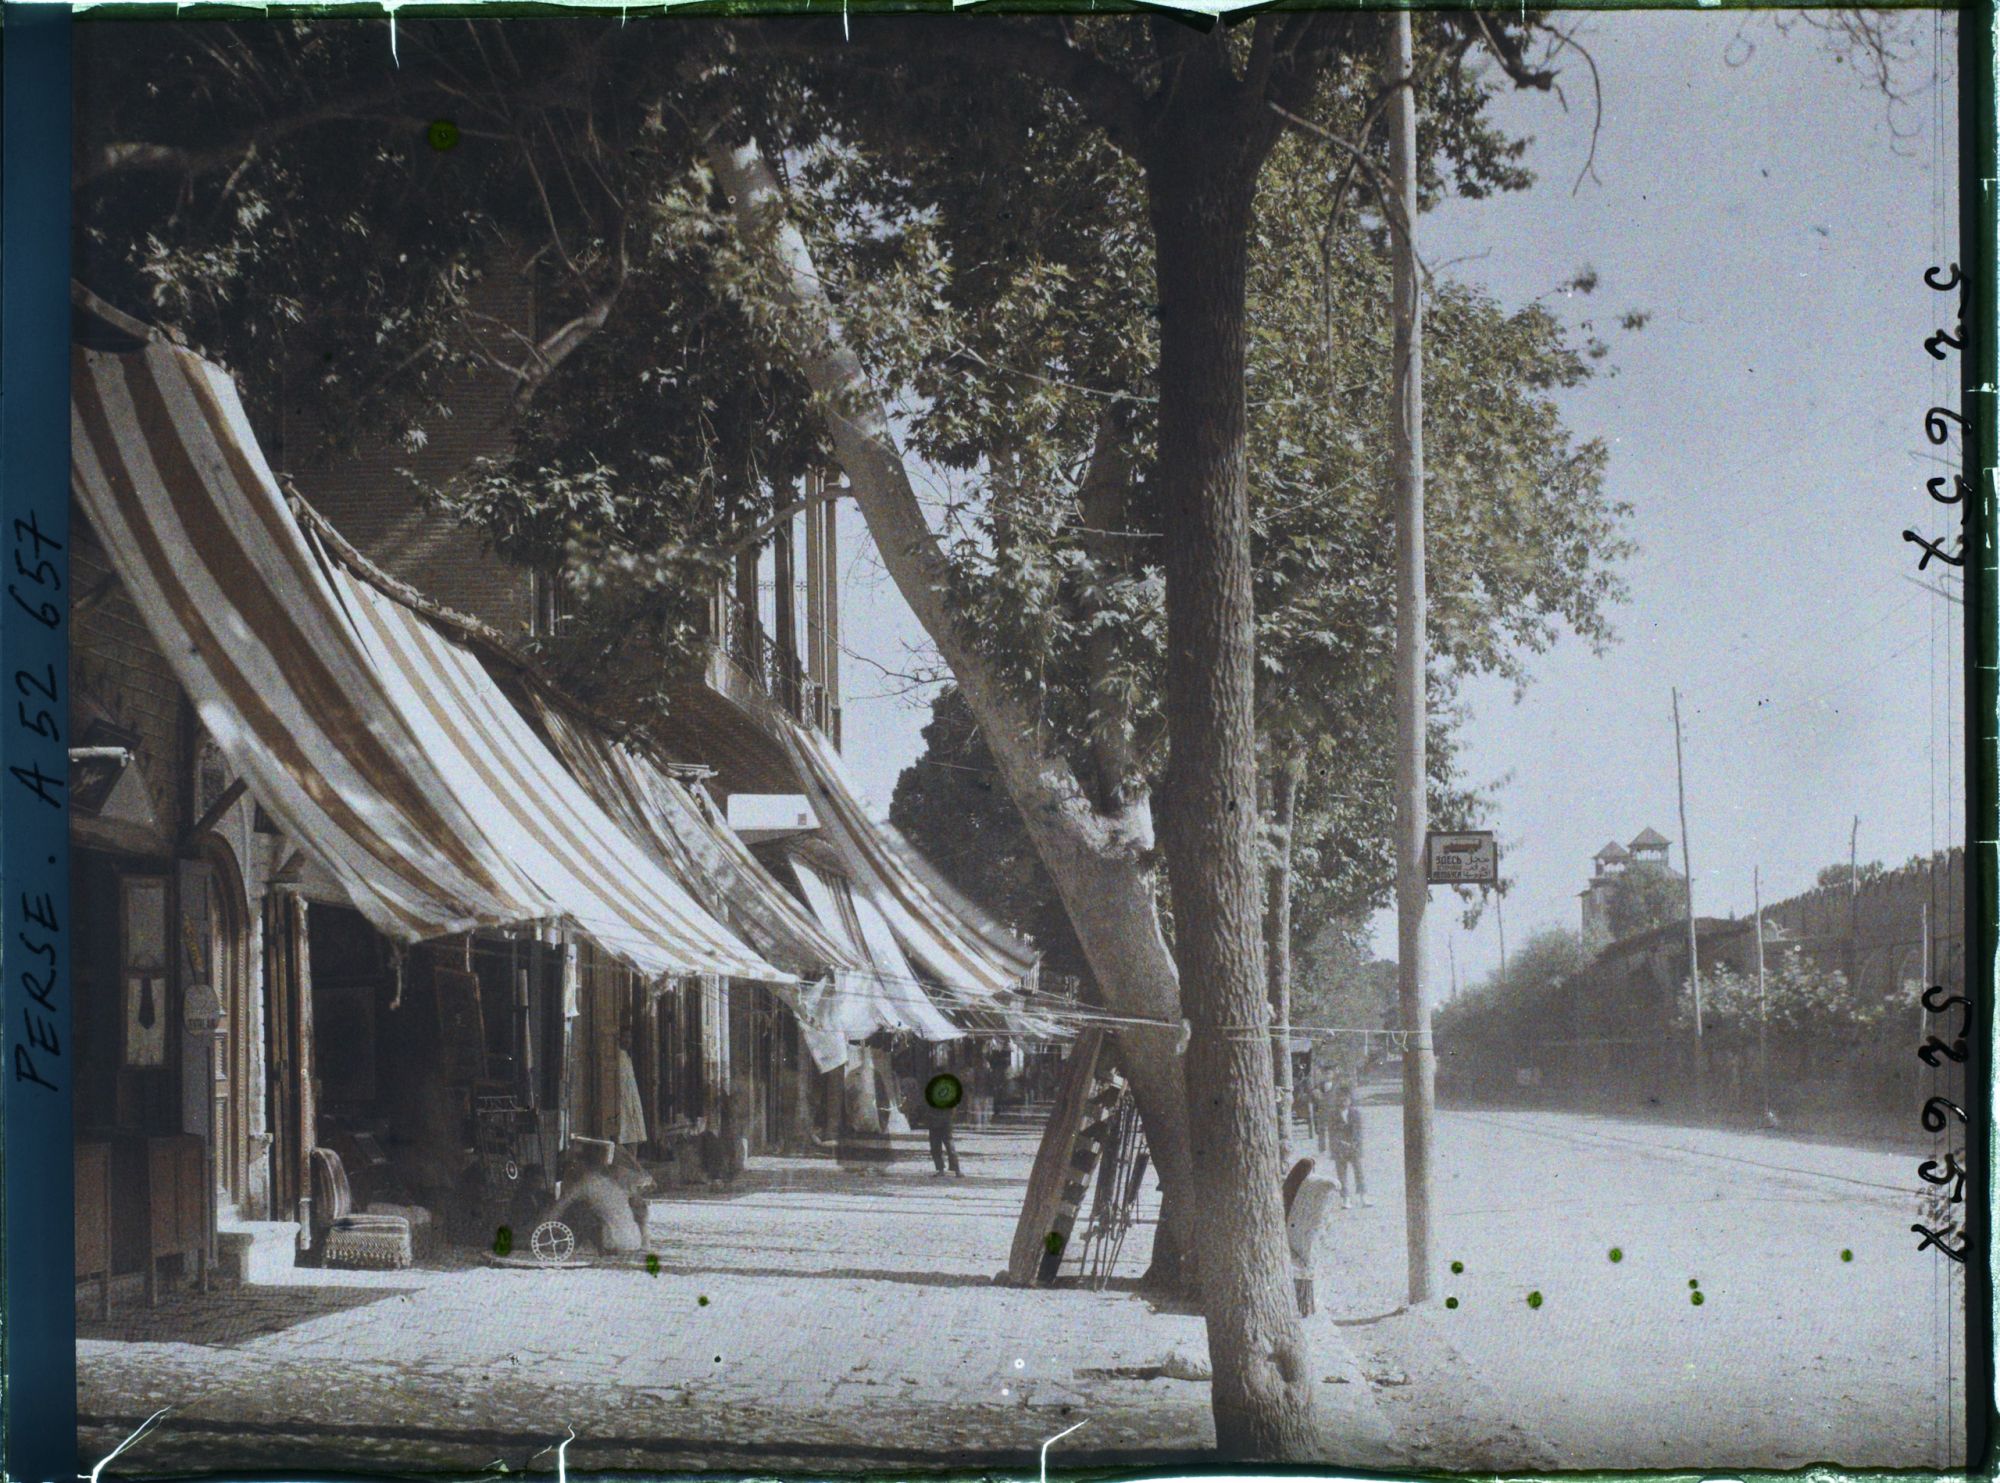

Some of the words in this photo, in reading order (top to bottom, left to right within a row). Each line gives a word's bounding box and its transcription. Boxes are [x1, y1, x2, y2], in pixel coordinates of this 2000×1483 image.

[7, 509, 63, 630] 657
[14, 663, 60, 742] 52
[8, 759, 65, 810] A
[1435, 855, 1462, 865] ЗДЕСЬ
